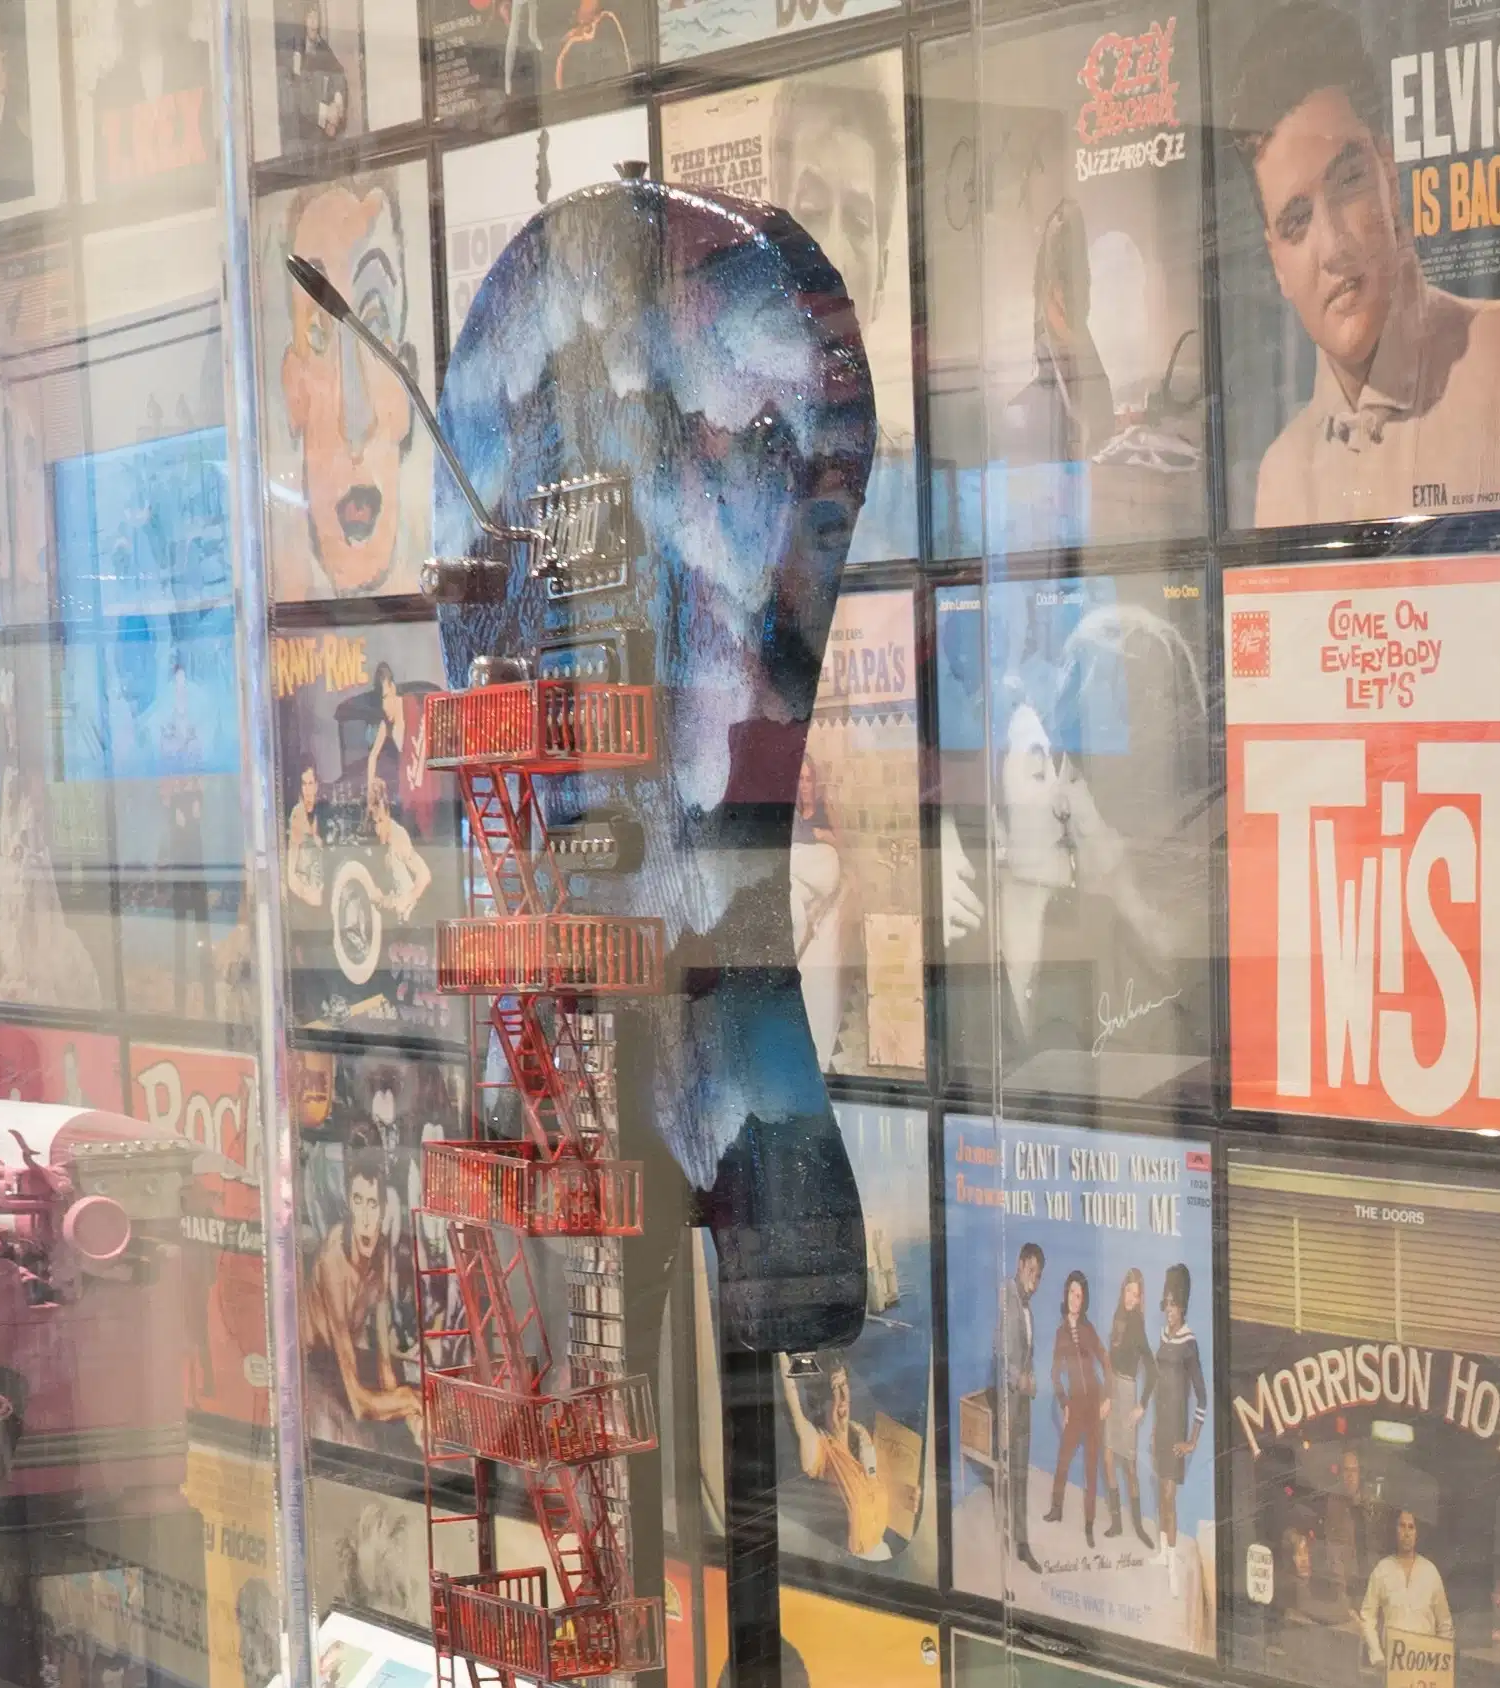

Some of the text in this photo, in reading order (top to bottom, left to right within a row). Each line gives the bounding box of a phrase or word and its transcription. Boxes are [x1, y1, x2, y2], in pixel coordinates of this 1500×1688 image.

[671, 135, 762, 175] THE TIMES
[681, 165, 725, 189] THEY
[726, 155, 762, 178] ARE
[1075, 140, 1147, 182] BLIZZARD
[1412, 166, 1441, 237] IS
[1412, 483, 1448, 508] EXTRA
[1452, 491, 1474, 504] ELVIS
[1329, 600, 1429, 641] COME ON
[324, 634, 369, 694] RAVE
[832, 641, 905, 697] PAPA'S
[1320, 639, 1442, 675] EVERYBODY
[1346, 671, 1417, 710] LET'S
[1015, 1140, 1061, 1182] CAN'T
[1071, 1147, 1121, 1184] STAND
[1129, 1152, 1182, 1184] MYSELF
[1046, 1189, 1073, 1222] YOU
[1082, 1191, 1138, 1230] TOUCH
[1149, 1191, 1182, 1237] ME
[1354, 1204, 1425, 1224] THE DOORS
[1233, 1344, 1432, 1460] MORRISON
[1390, 1639, 1451, 1672] ROOMS
